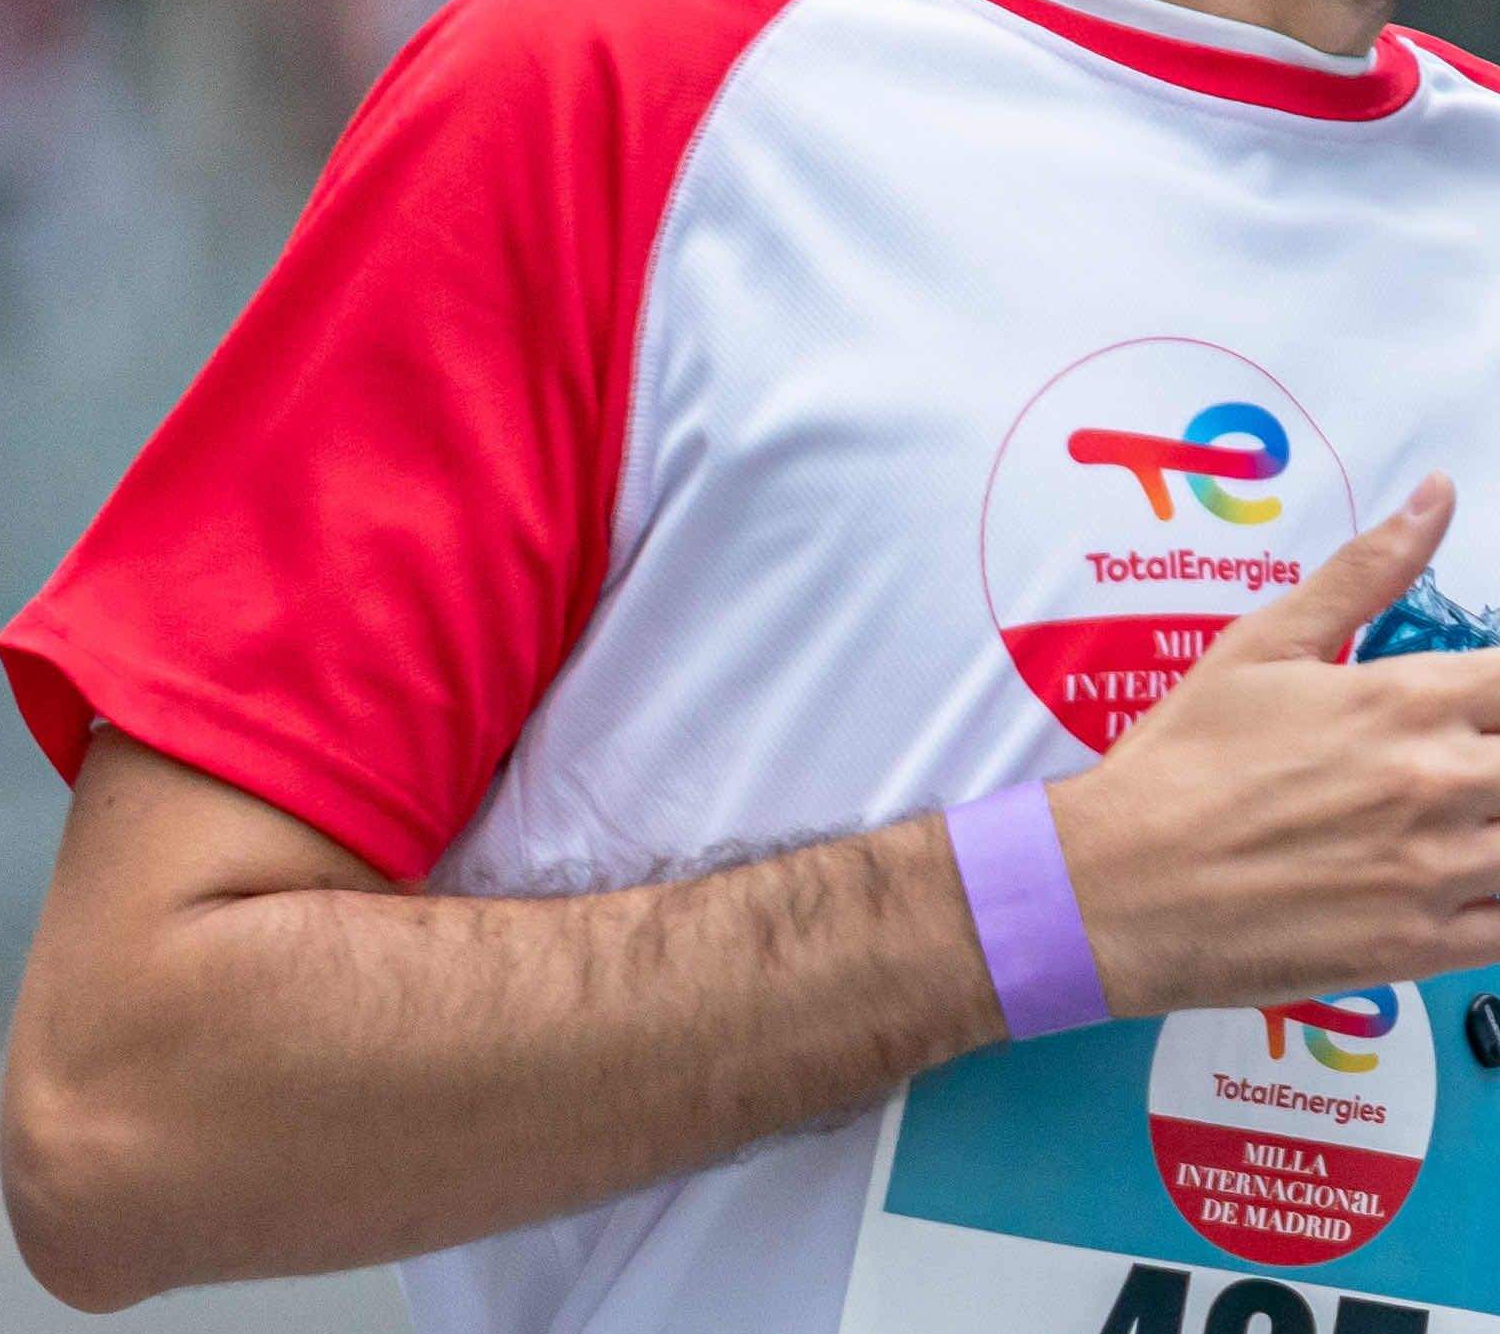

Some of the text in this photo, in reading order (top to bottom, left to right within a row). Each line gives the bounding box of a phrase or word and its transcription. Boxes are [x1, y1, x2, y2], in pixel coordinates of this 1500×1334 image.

[1085, 549, 1300, 591] TotalEnergies
[1213, 1073, 1387, 1125] TotalEnergies
[1243, 1142, 1328, 1178] MILLA
[1201, 1197, 1352, 1243] DE MADRID
